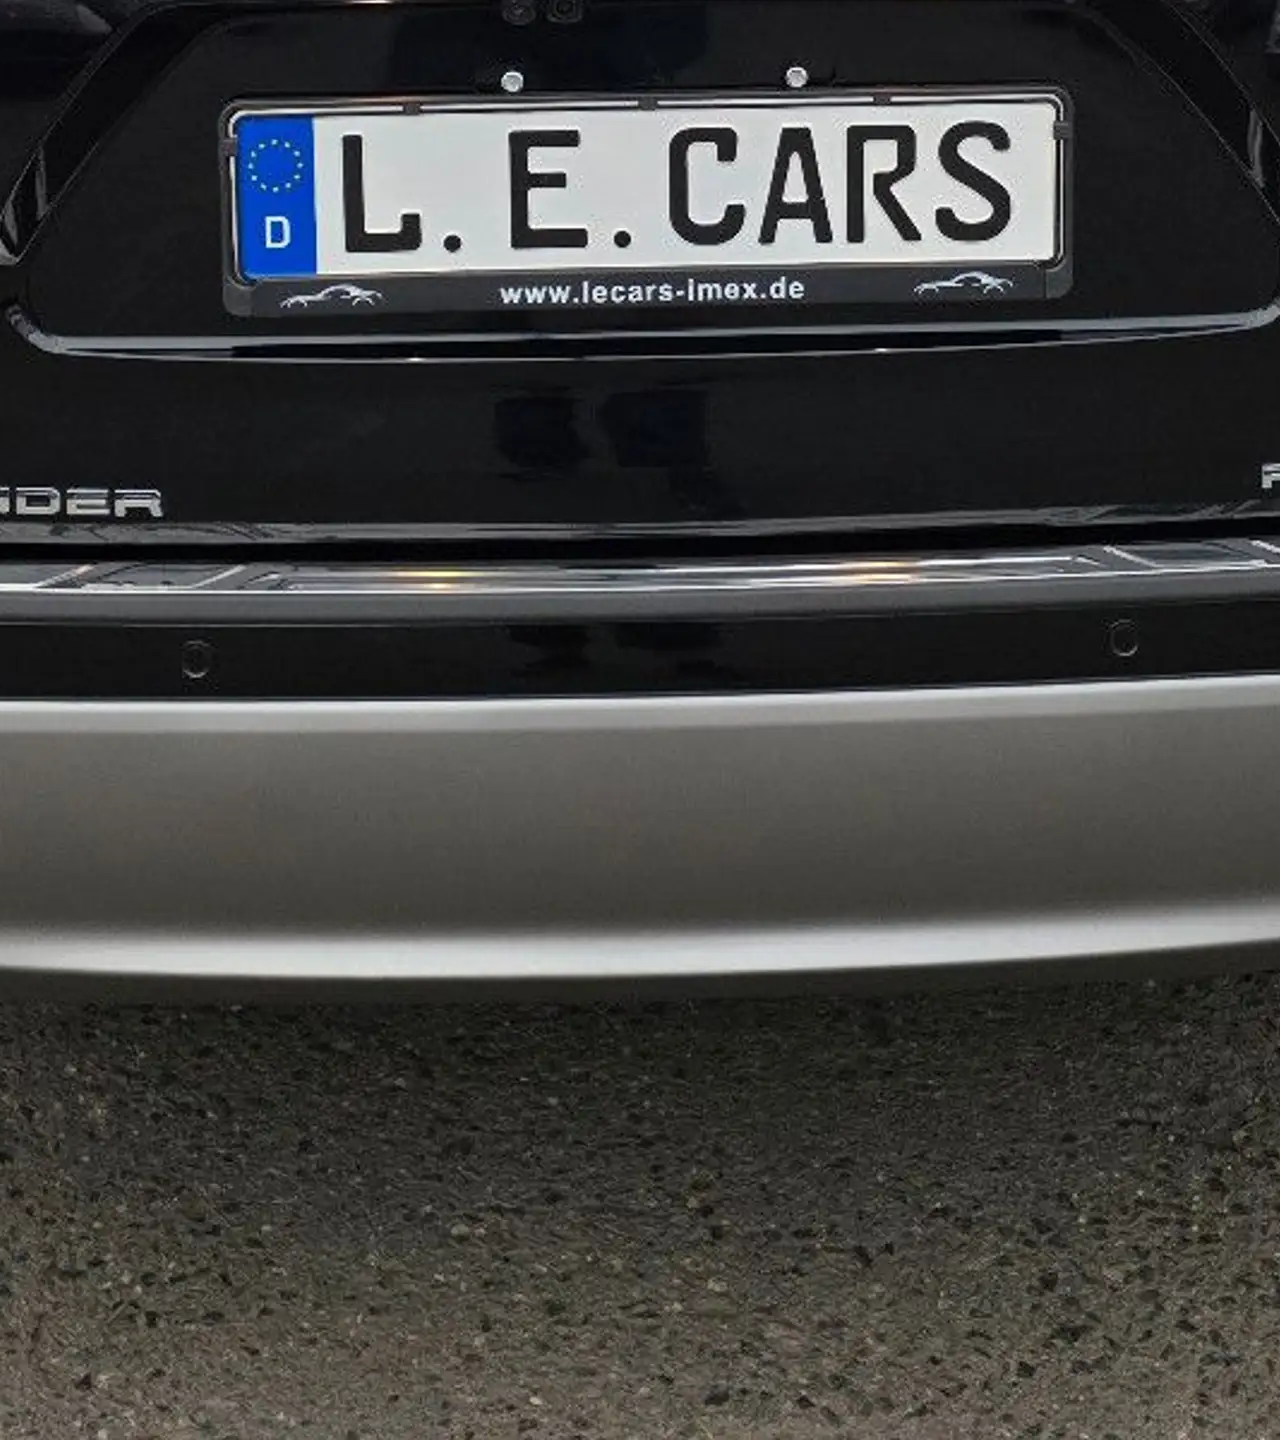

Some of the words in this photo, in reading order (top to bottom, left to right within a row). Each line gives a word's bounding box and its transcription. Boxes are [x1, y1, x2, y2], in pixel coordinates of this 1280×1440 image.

[668, 120, 1012, 246] CARS
[265, 216, 291, 249] D
[500, 277, 805, 304] www.lecars-imex.de
